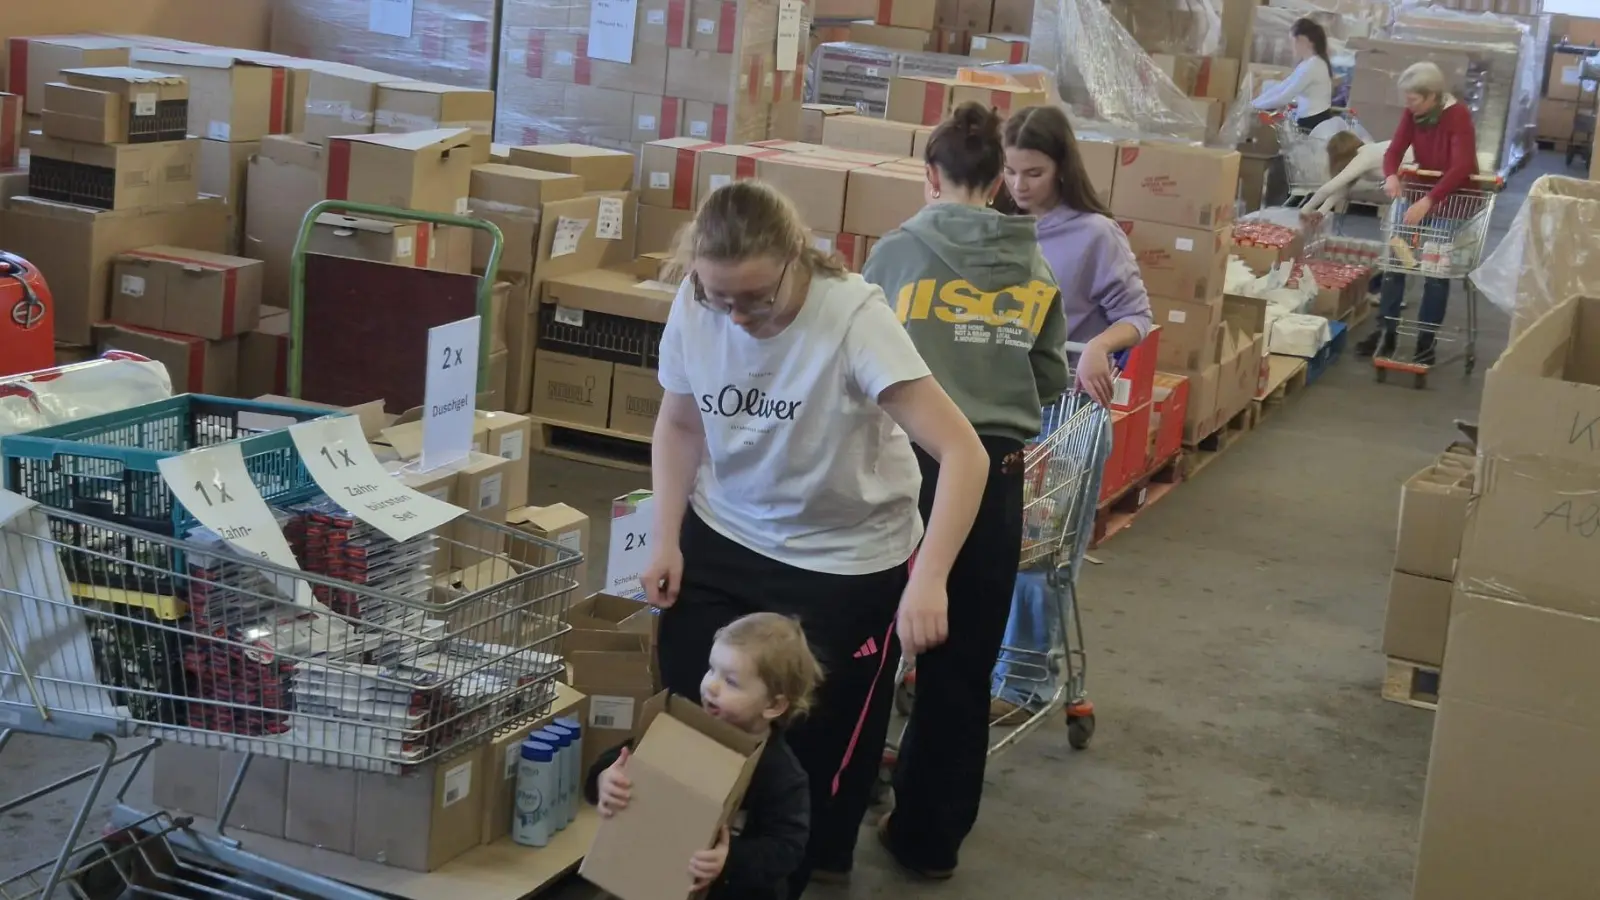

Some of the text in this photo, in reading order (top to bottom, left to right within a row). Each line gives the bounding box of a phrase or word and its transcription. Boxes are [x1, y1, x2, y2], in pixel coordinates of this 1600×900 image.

[442, 347, 463, 370] 2 x
[432, 394, 468, 417] Duschgel
[700, 383, 802, 421] s.Oliver
[320, 446, 357, 470] 1 x
[193, 480, 234, 507] 1 x
[343, 483, 379, 498] Zahn-
[364, 494, 412, 512] bürsten
[392, 510, 418, 522] Set
[217, 525, 252, 540] Zahn-
[624, 532, 647, 552] 2 x
